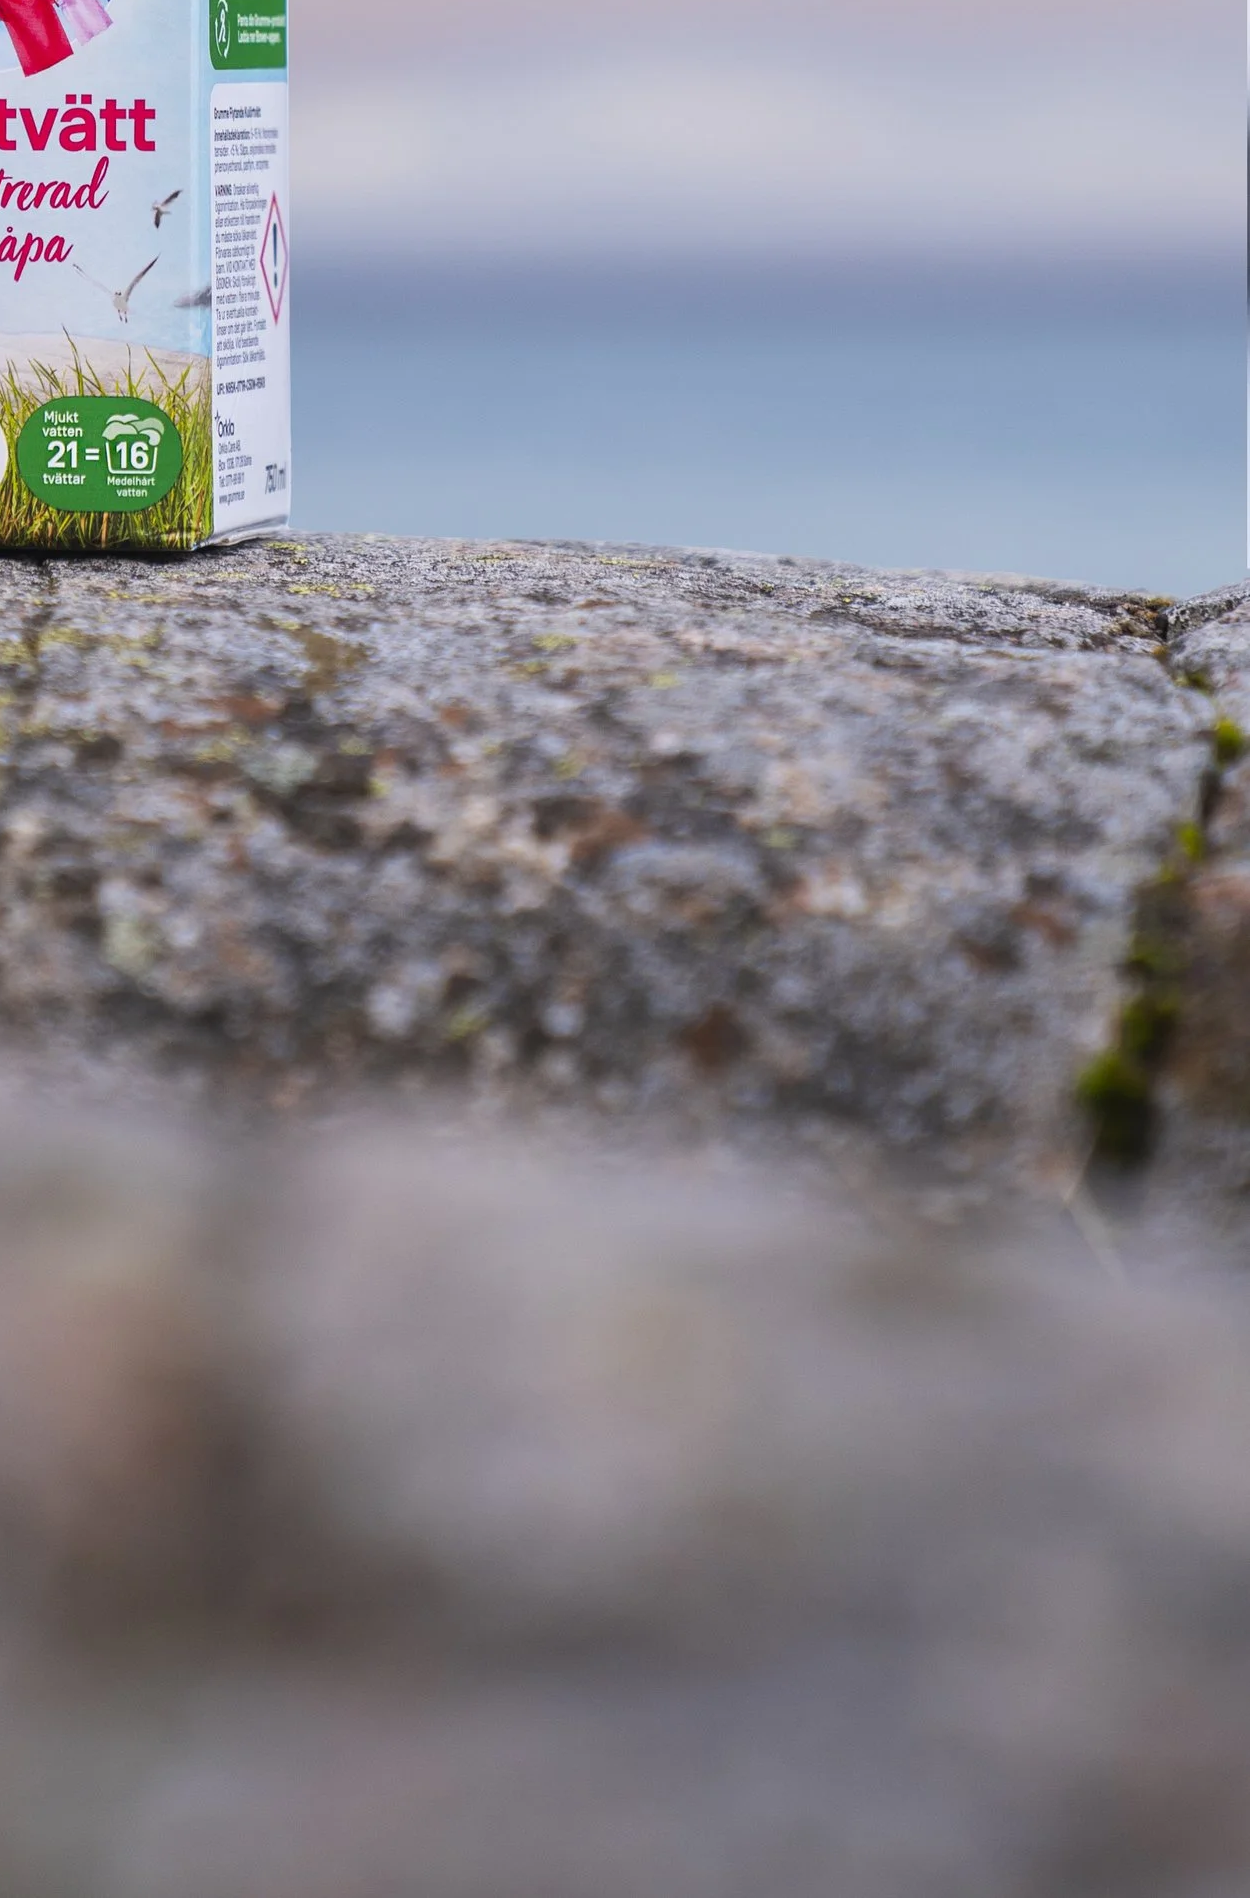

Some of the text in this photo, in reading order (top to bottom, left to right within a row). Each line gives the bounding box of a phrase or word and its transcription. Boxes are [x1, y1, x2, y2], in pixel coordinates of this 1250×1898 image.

[44, 411, 79, 424] Mjukt
[42, 426, 83, 438] vatten
[47, 440, 78, 468] 21
[115, 441, 149, 469] 16
[42, 473, 86, 485] tvättar
[107, 476, 155, 486] Medelhårt
[116, 487, 148, 497] vatten
